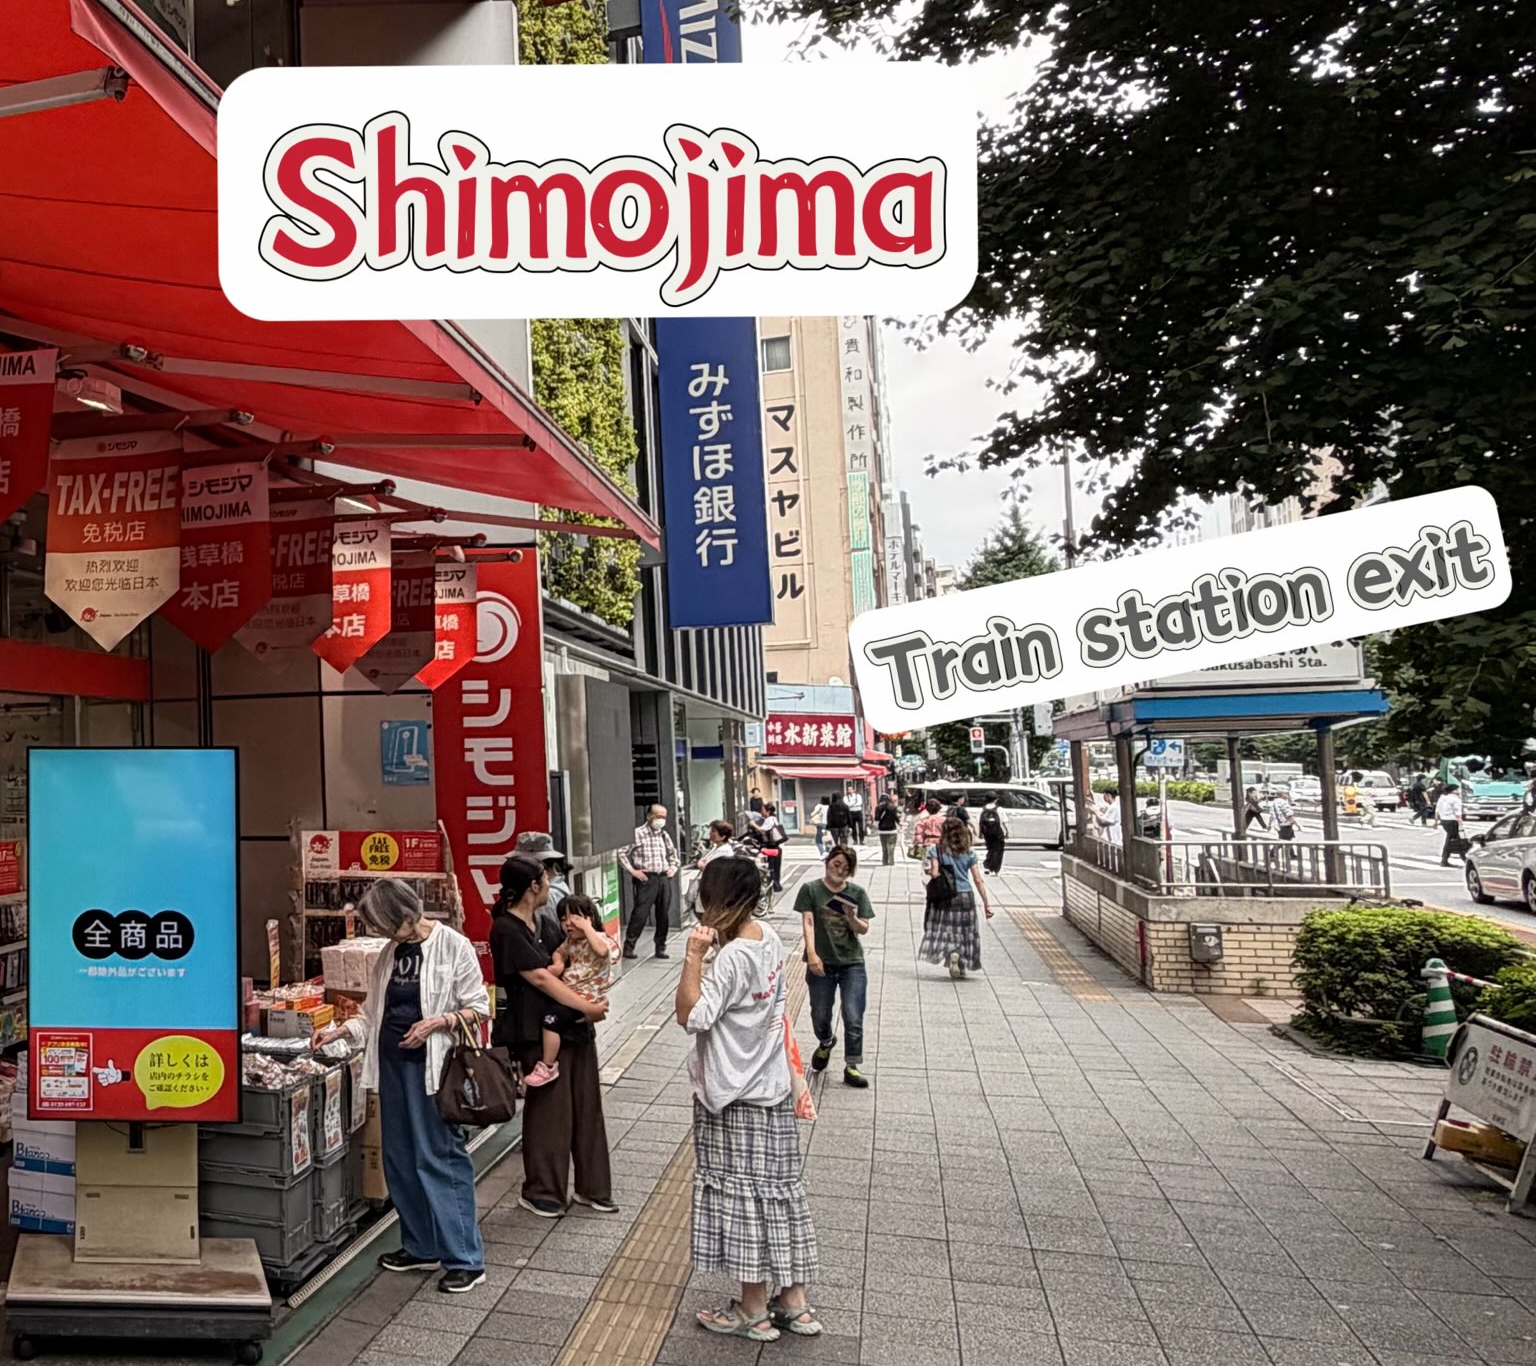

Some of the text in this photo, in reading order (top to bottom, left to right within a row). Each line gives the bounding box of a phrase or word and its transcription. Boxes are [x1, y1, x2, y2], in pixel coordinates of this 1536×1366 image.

[687, 362, 739, 568] みずほ銀行
[56, 465, 180, 516] TAX-FREE
[188, 475, 253, 498] シモジマ
[766, 404, 805, 600] マスヤビル
[82, 521, 147, 544] 免税店
[181, 578, 240, 611] 本店
[1298, 655, 1328, 668] Sta.
[83, 919, 183, 949] 全商品
[149, 1053, 210, 1068] 詳しくは
[1490, 1044, 1536, 1082] 駐輪禁
